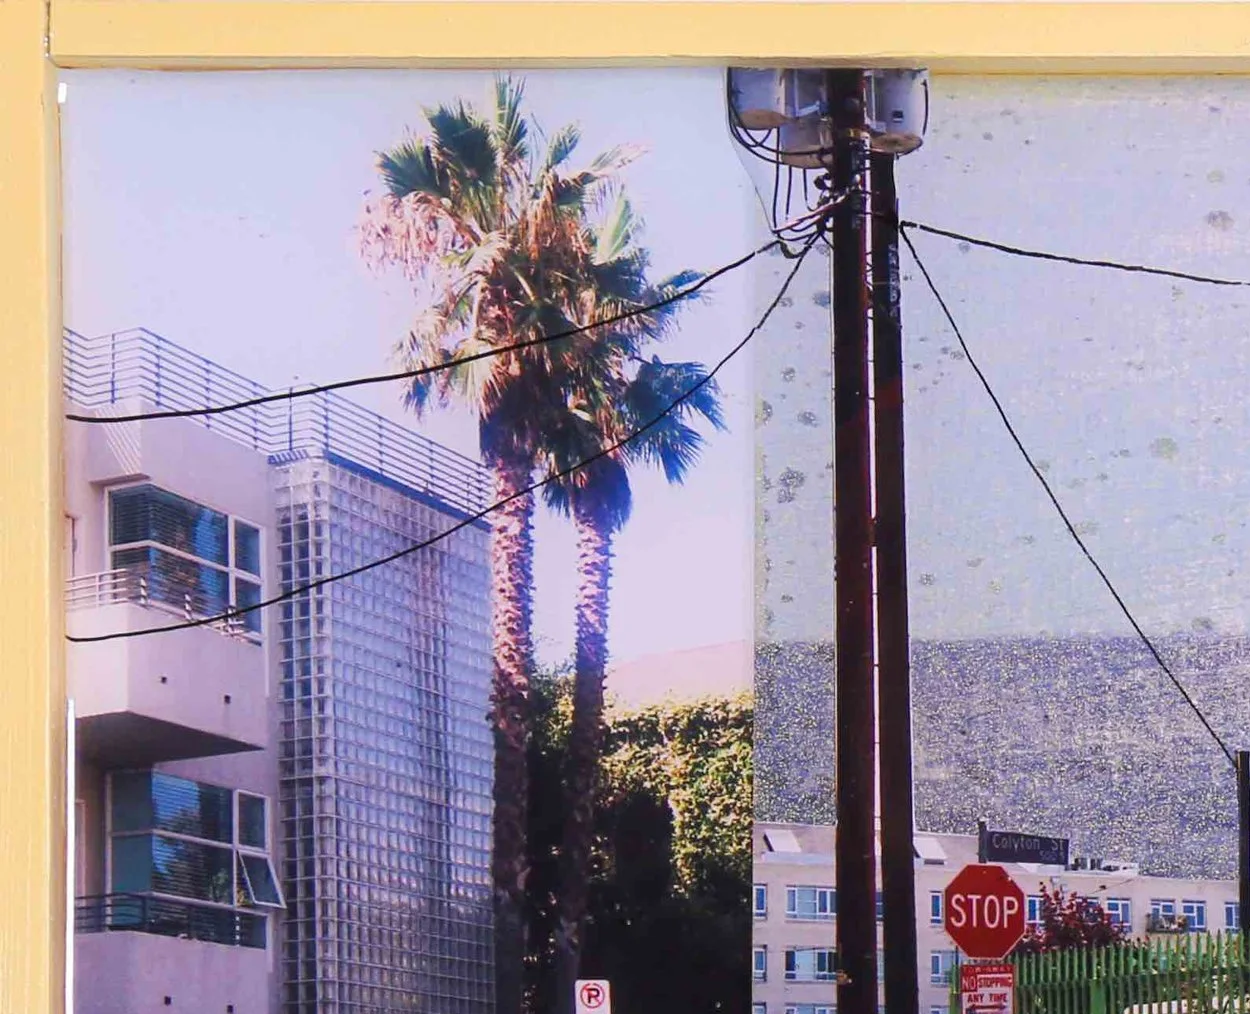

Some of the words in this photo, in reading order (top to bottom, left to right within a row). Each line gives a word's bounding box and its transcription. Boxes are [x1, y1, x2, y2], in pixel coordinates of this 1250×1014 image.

[950, 894, 1019, 929] STOP
[962, 975, 977, 990] NO
[967, 993, 984, 1003] ANY
